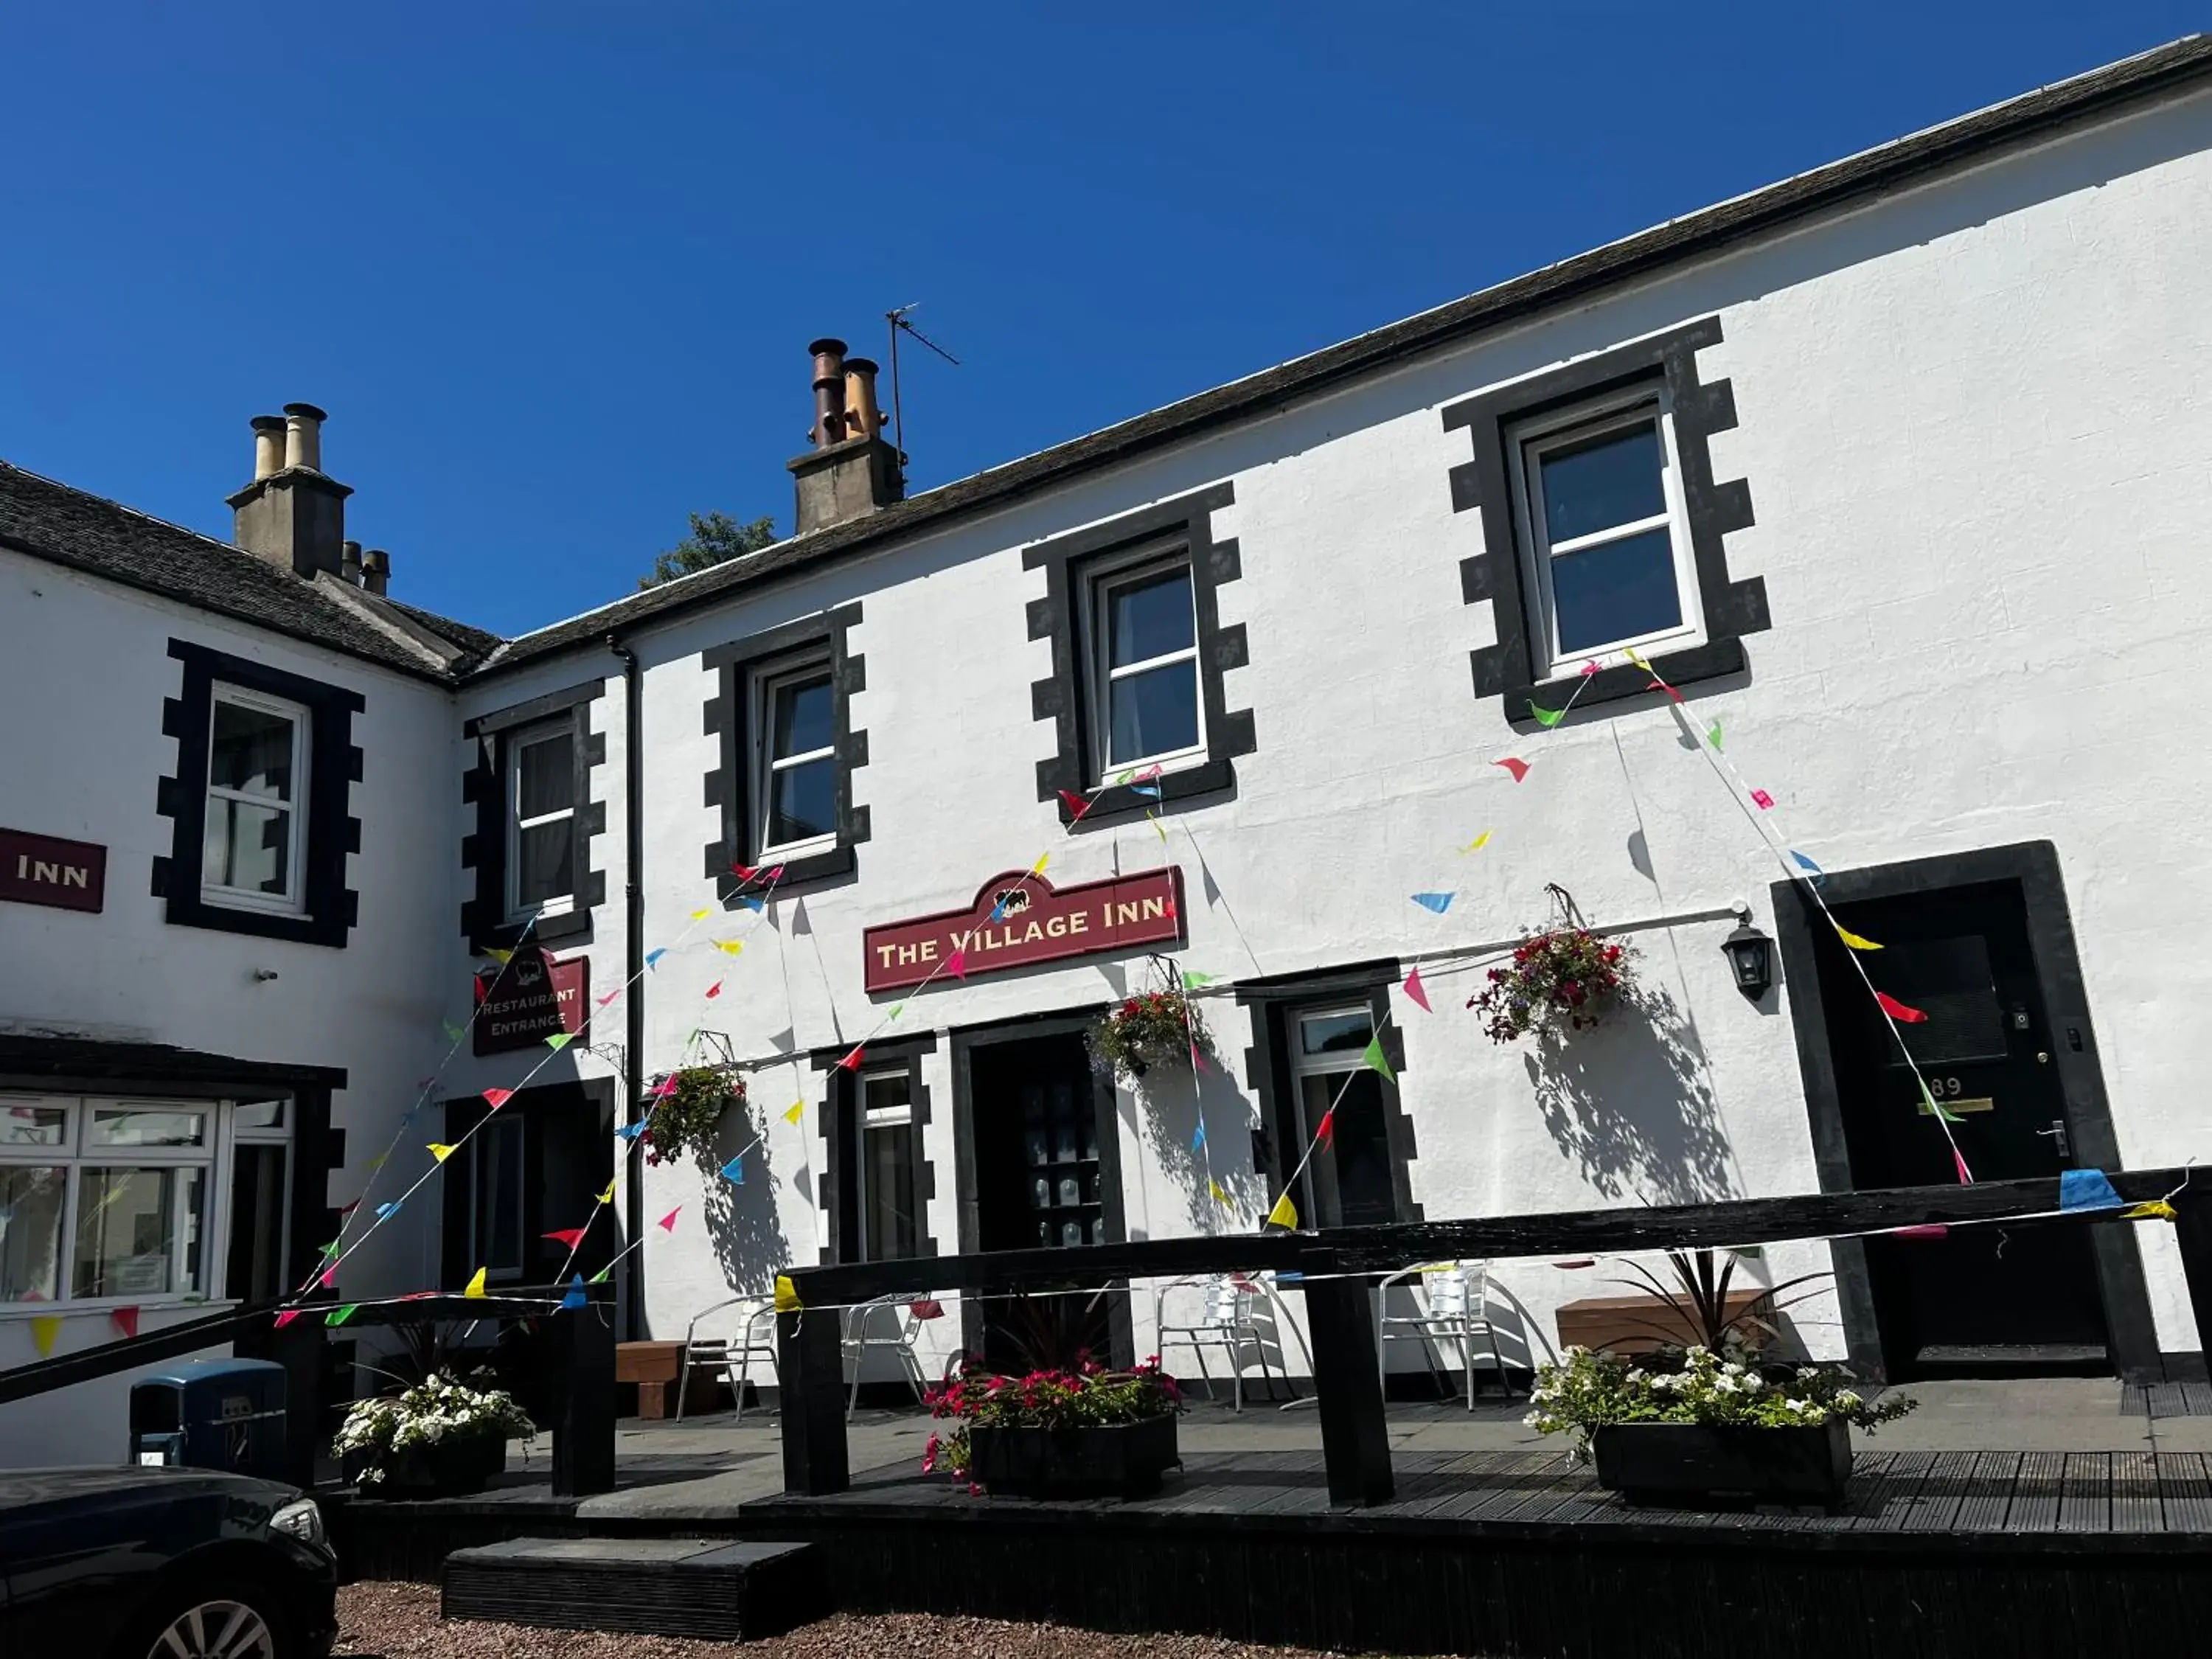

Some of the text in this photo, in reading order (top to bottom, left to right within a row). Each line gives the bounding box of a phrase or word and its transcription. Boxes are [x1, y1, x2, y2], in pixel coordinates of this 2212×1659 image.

[18, 855, 88, 888] INN
[877, 896, 1164, 968] THE VILLAGE INN
[483, 988, 575, 1016] RESTAURANT
[491, 1012, 566, 1036] ENTRANCE
[1931, 1077, 1961, 1096] 89
